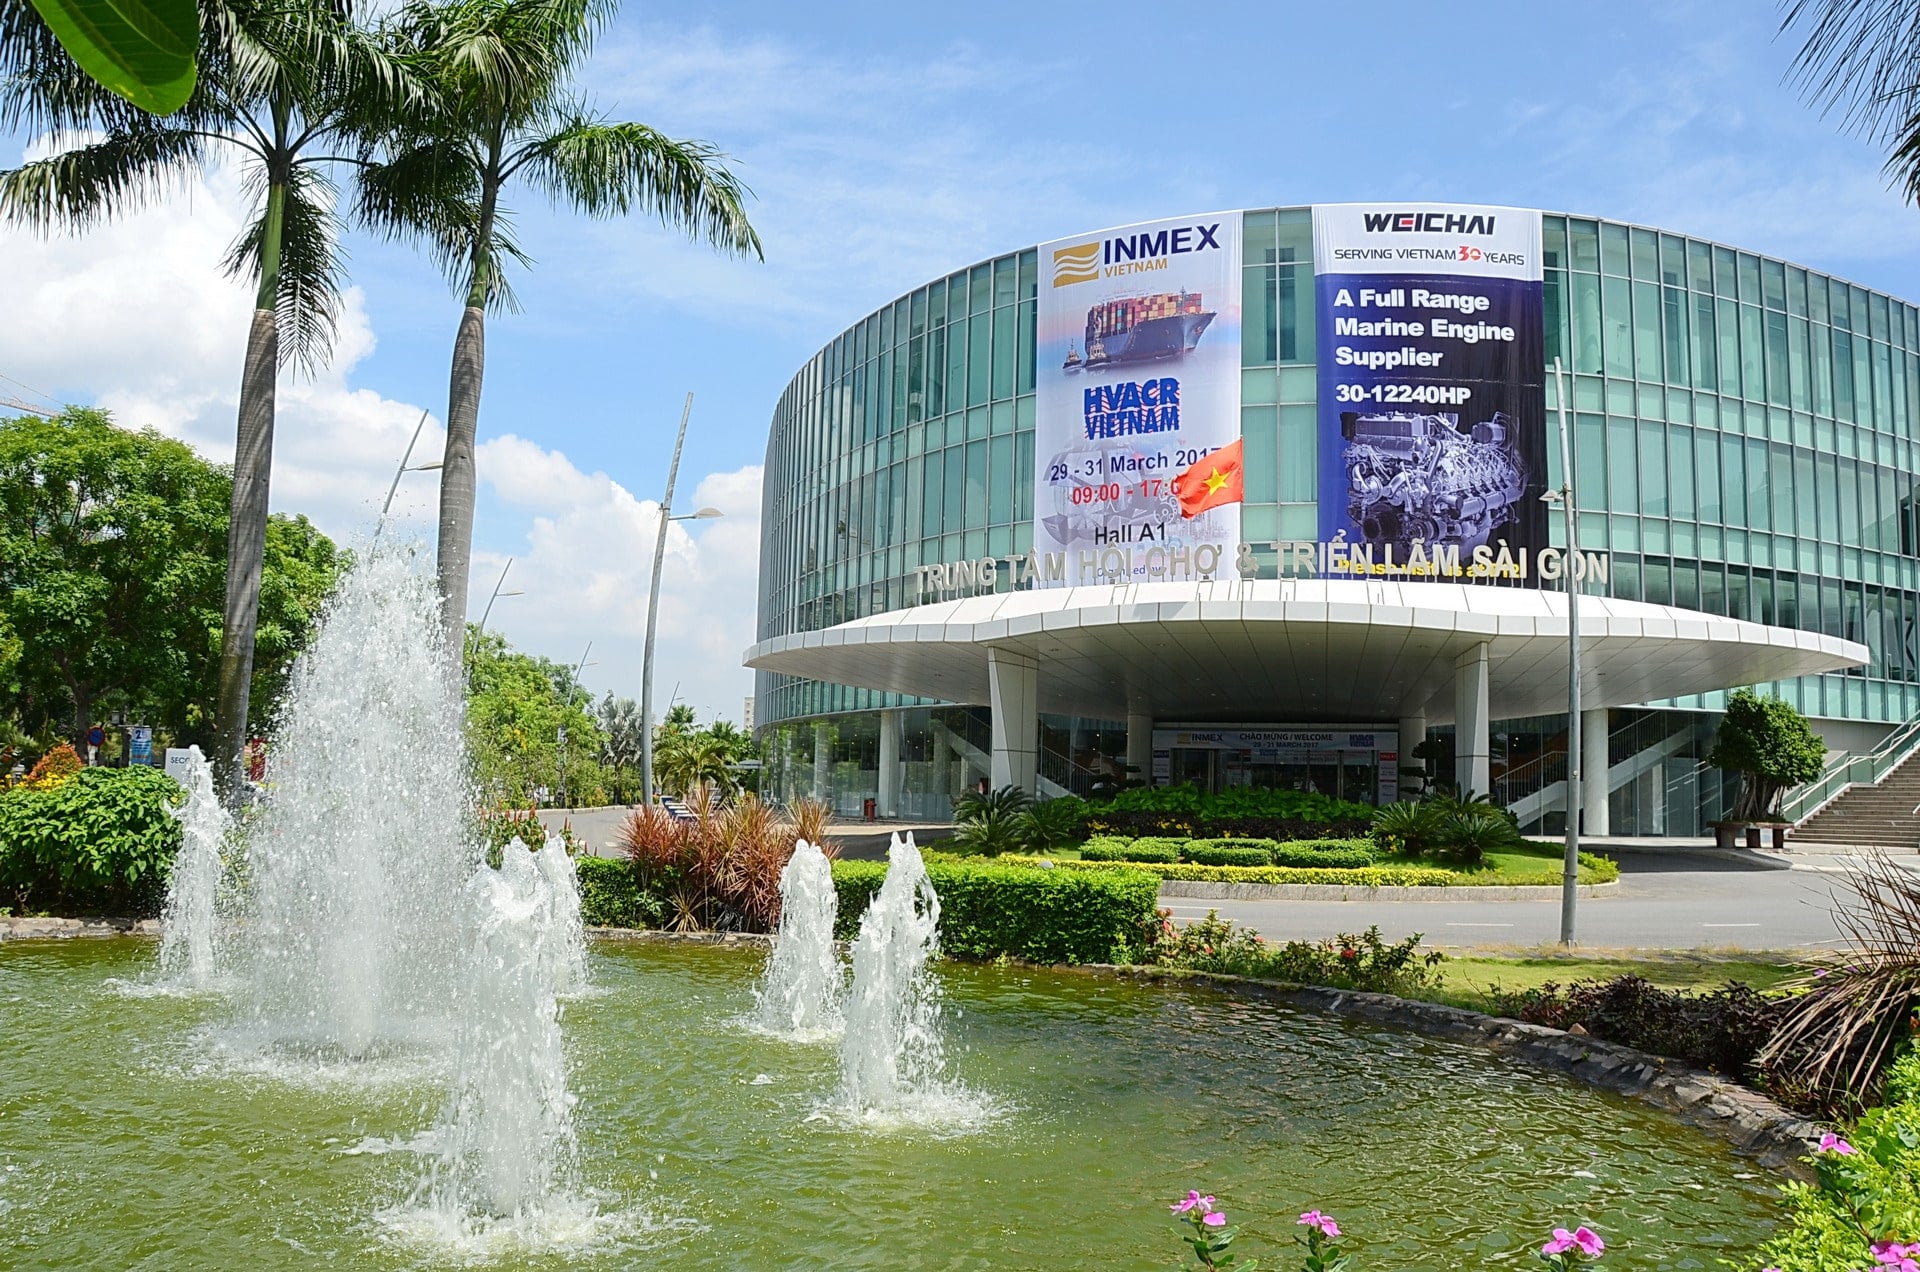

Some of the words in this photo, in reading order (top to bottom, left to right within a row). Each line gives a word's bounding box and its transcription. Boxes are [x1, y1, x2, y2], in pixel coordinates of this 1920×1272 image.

[1363, 212, 1496, 236] WEICHAI
[1103, 223, 1221, 265] INMEX
[1334, 248, 1393, 260] SERVING
[1395, 248, 1457, 261] VIETNAM
[1457, 245, 1482, 262] 30
[1483, 252, 1526, 266] YEARS
[1103, 257, 1169, 279] VIETNAM
[1333, 288, 1355, 308] A
[1359, 288, 1406, 308] Full
[1411, 289, 1490, 314] Range
[1335, 317, 1425, 338] Marine
[1431, 318, 1516, 344] Engine
[1335, 346, 1444, 371] Supplier
[1084, 377, 1180, 415] HVACR
[1335, 384, 1472, 405] 30-12240HP
[1084, 406, 1180, 441] VIETNAM
[1051, 463, 1068, 482] 29
[1085, 458, 1102, 477] 31
[1110, 451, 1169, 473] March
[1175, 447, 1223, 467] 201
[1072, 482, 1121, 506] 09:00
[1094, 523, 1132, 546] Hall
[1139, 521, 1166, 542] A1
[913, 556, 998, 594] TRUNG
[1005, 546, 1068, 584] TÂM
[1236, 542, 1258, 574] &
[1270, 528, 1373, 574] TRIỂN
[1384, 537, 1459, 576] LÃM
[1472, 539, 1527, 579] SÀI
[1191, 733, 1224, 742] INMEX
[1294, 733, 1334, 742] WELCOME
